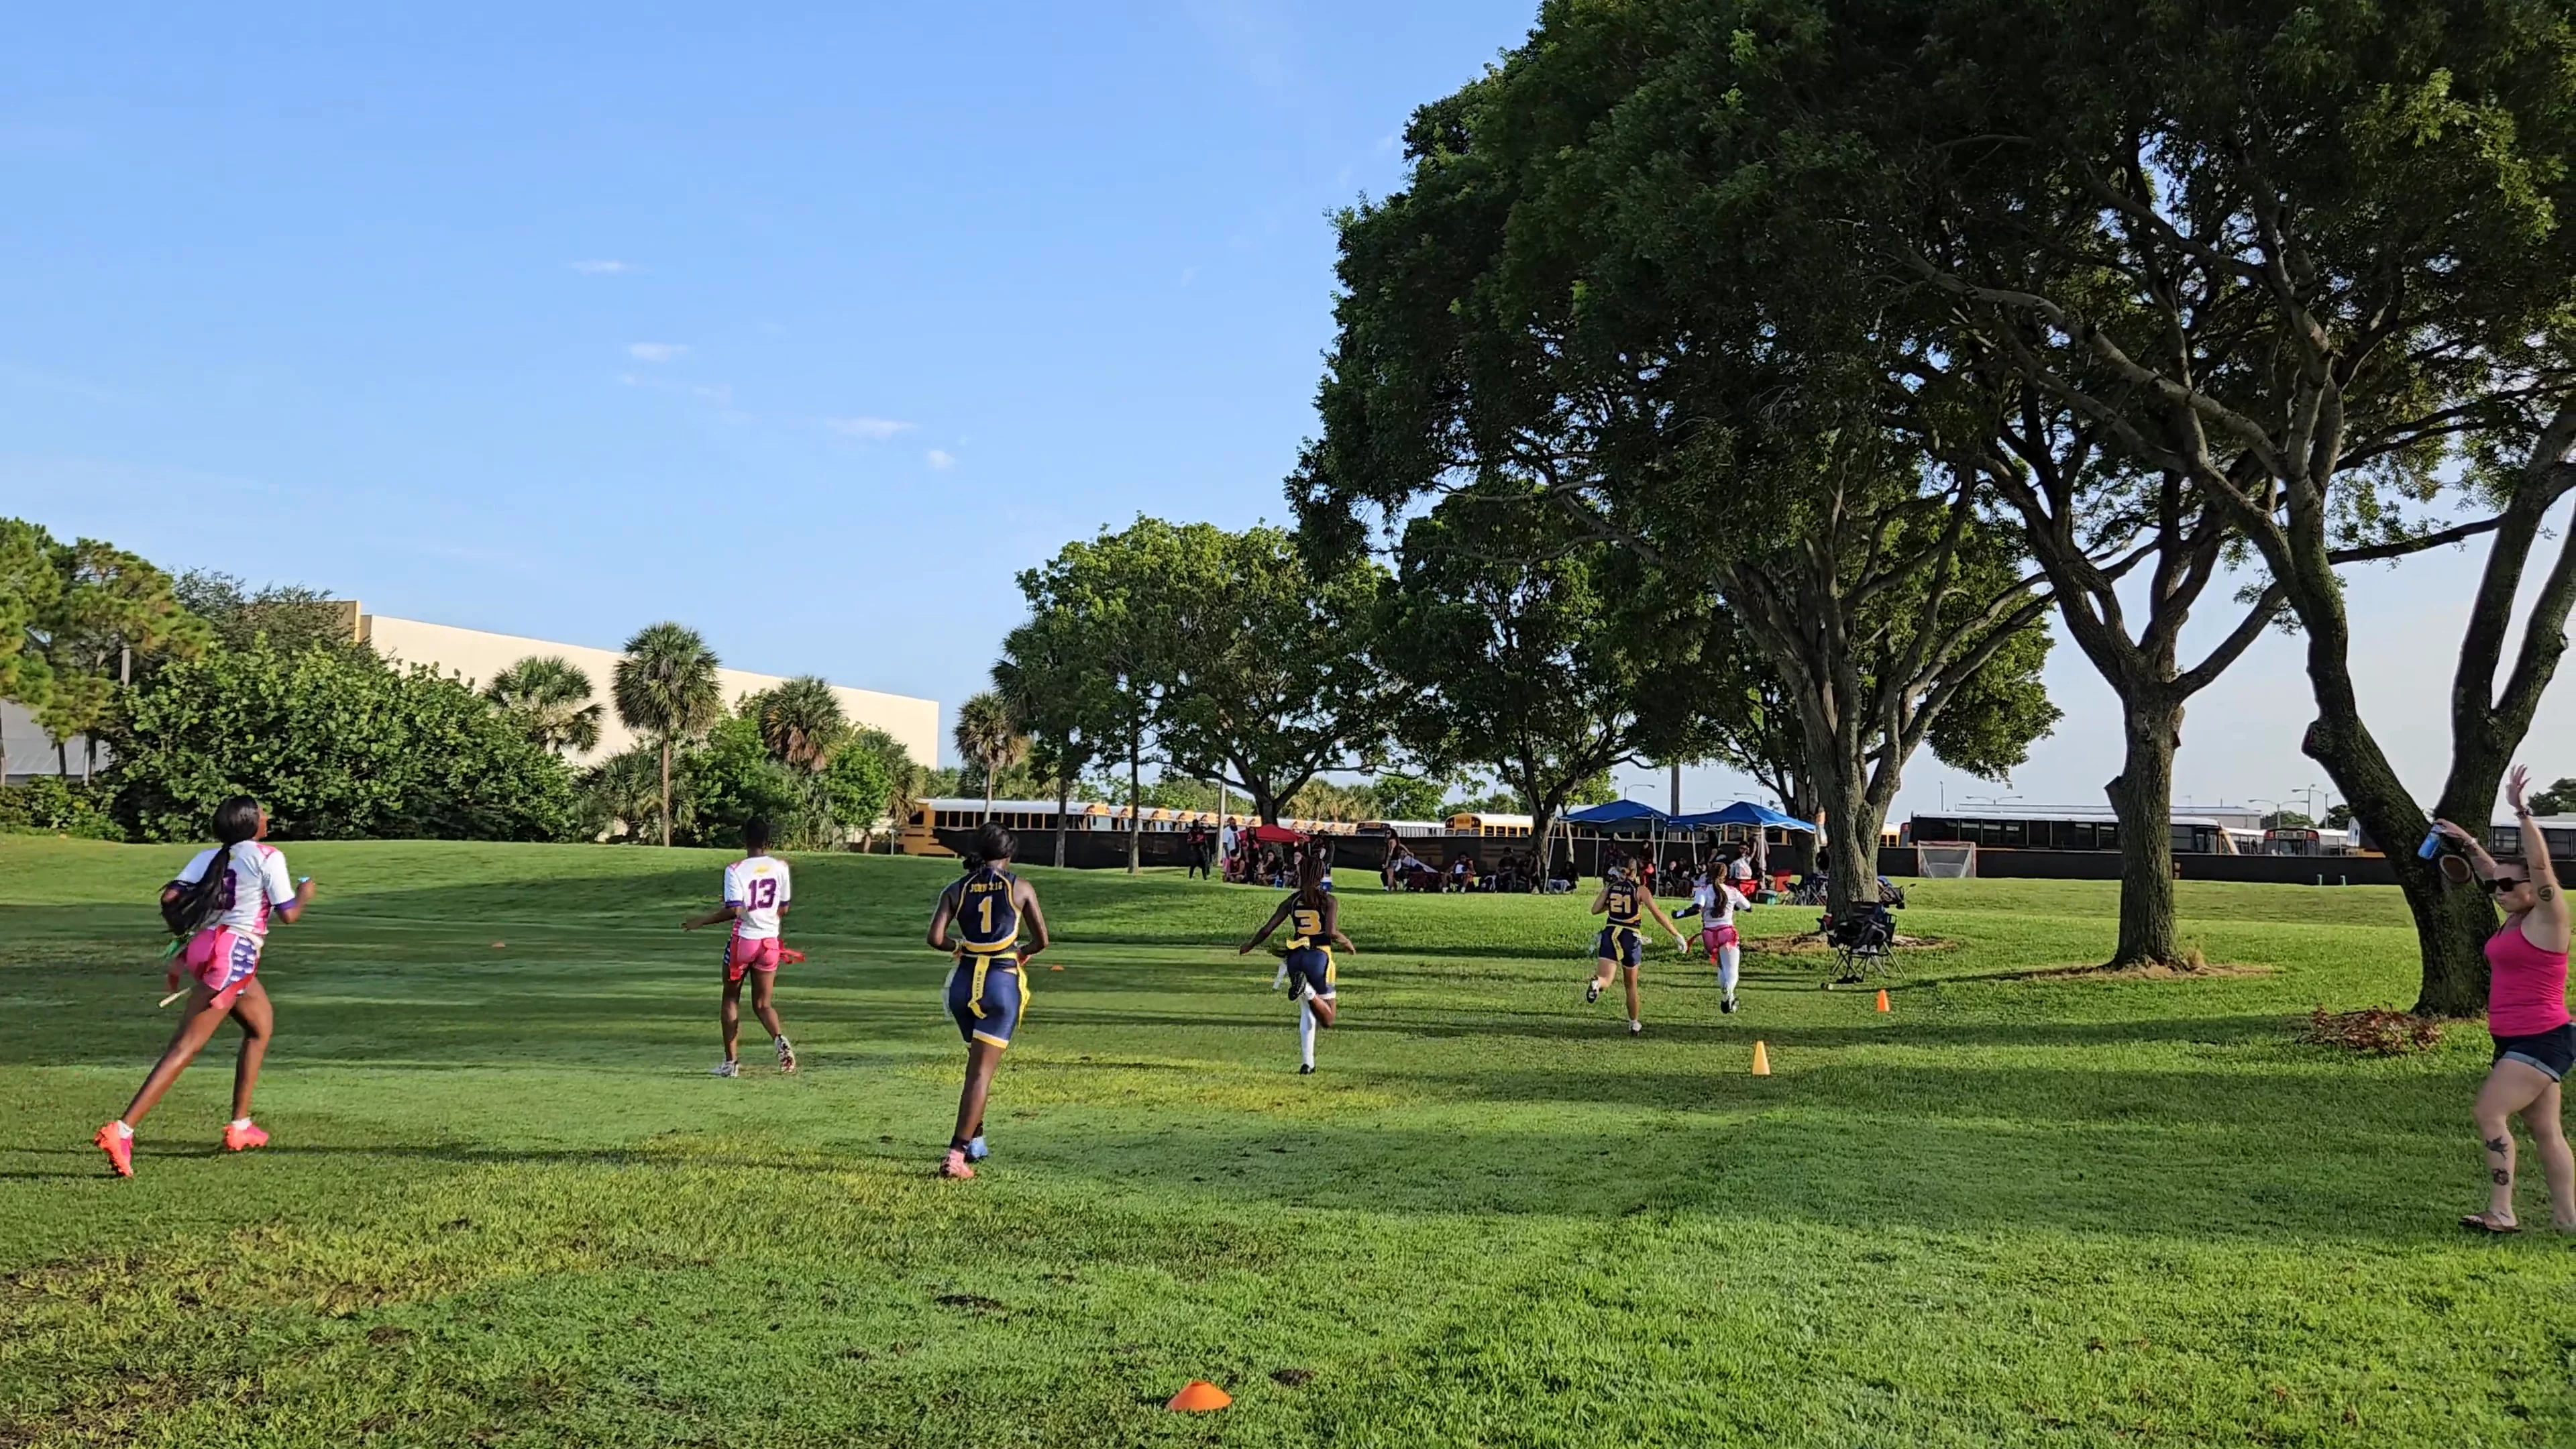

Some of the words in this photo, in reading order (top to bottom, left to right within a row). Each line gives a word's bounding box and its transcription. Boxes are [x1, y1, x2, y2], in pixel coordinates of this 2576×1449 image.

[747, 878, 777, 912] 13
[1610, 893, 1631, 914] 21
[978, 896, 993, 933] 1
[1294, 910, 1322, 935] 3
